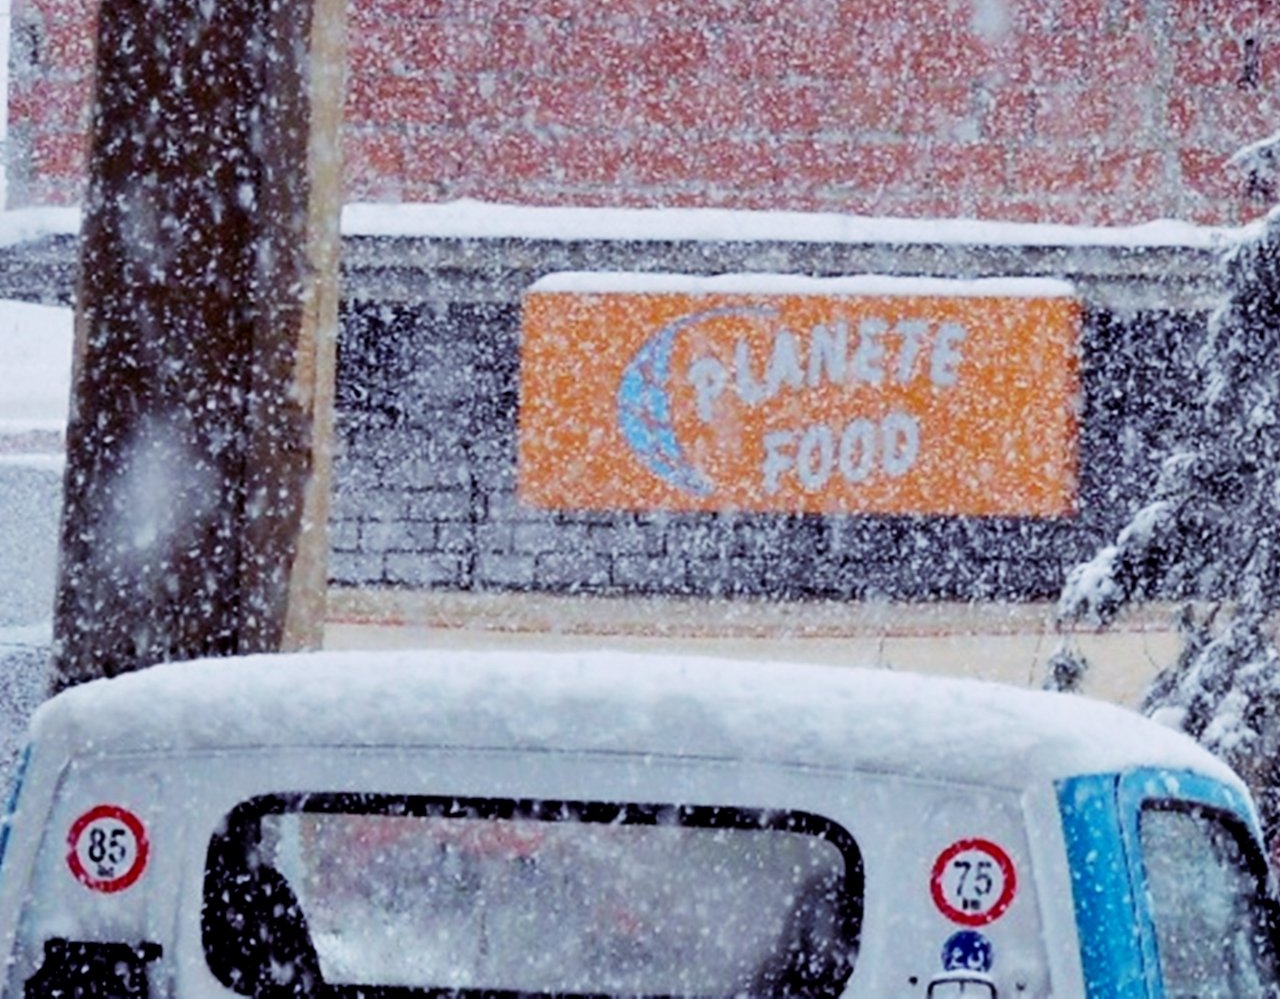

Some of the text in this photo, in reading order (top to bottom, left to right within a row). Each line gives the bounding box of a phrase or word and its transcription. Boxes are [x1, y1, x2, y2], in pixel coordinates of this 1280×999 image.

[687, 316, 967, 423] PLANETE
[761, 409, 920, 495] FOOD
[88, 828, 126, 864] 85
[953, 860, 992, 896] 75
